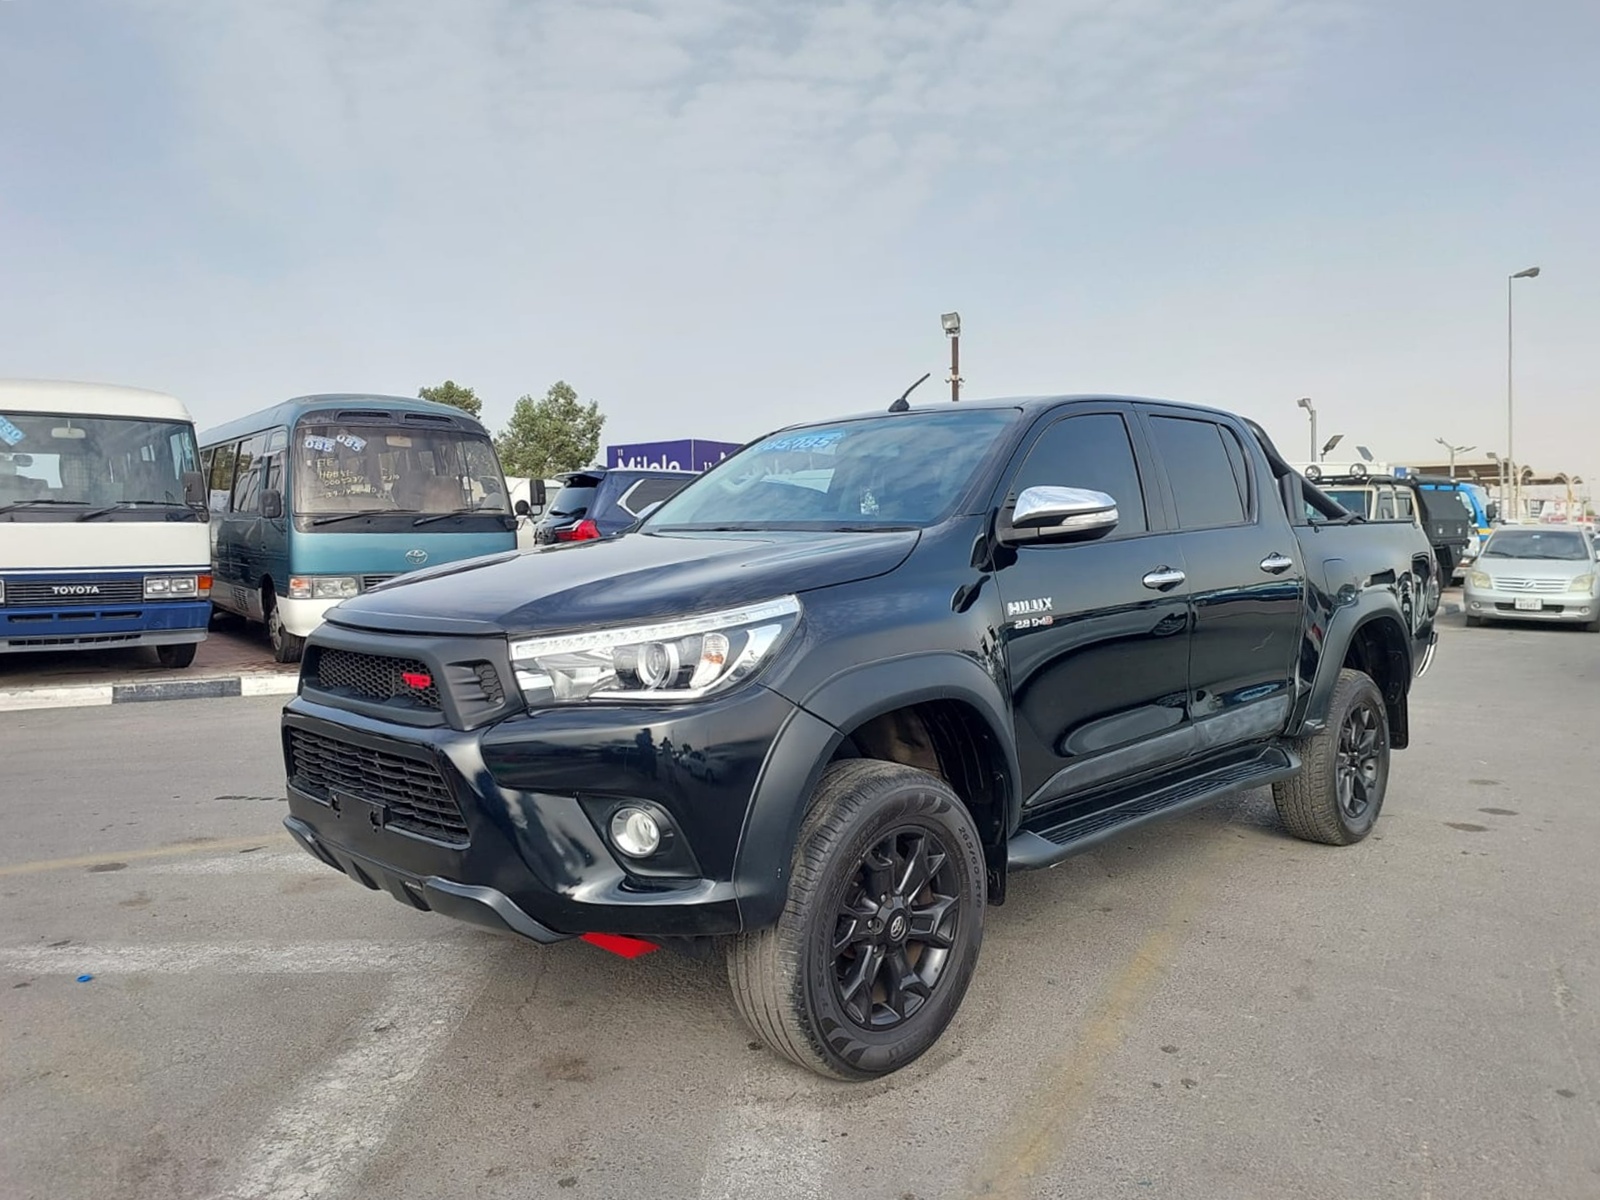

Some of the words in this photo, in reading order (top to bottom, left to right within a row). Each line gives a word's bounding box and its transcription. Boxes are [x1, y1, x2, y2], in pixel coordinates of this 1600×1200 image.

[51, 585, 100, 595] TOYOTA
[1007, 597, 1053, 616] HILUX
[958, 826, 980, 875] 265/60
